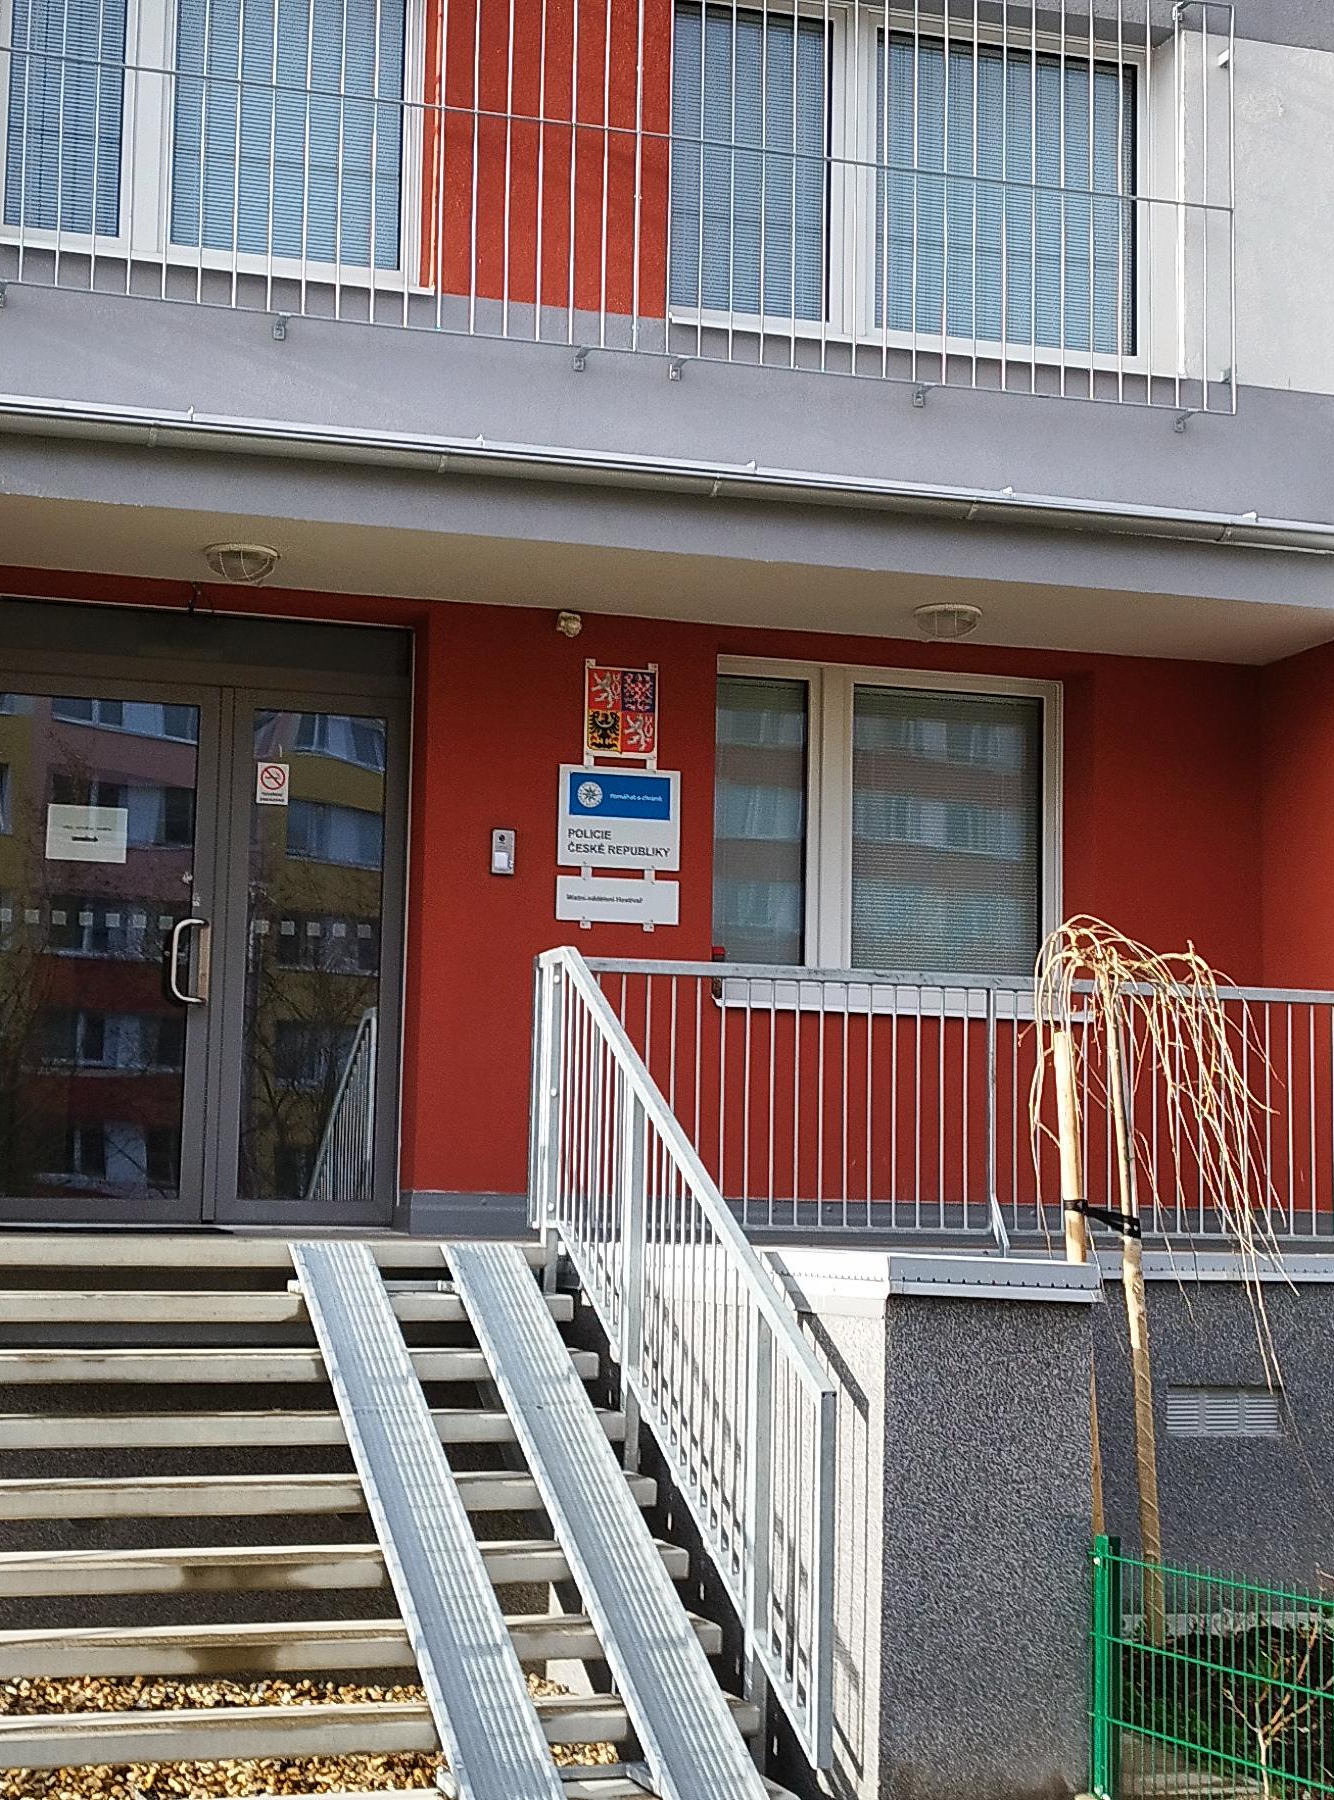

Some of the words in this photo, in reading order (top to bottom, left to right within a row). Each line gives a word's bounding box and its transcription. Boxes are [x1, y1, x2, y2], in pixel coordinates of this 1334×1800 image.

[568, 828, 612, 840] POLICIE
[567, 842, 606, 855] ČESKÉ
[608, 844, 671, 858] REPUBLIKY
